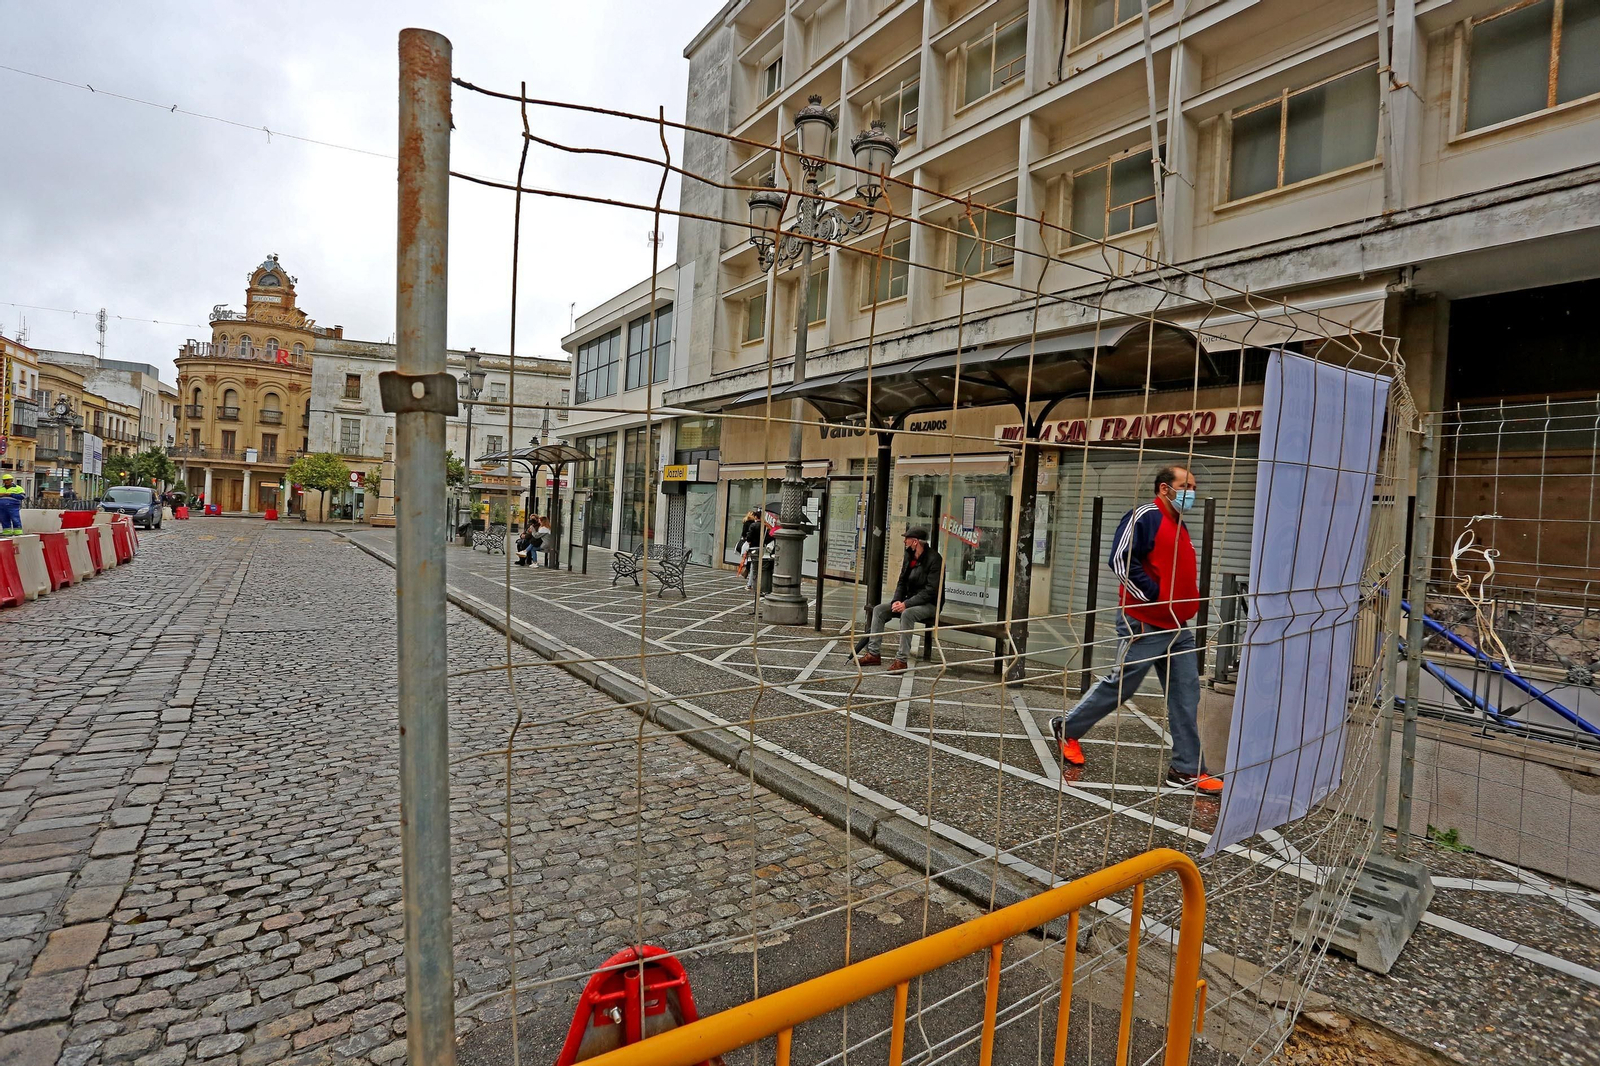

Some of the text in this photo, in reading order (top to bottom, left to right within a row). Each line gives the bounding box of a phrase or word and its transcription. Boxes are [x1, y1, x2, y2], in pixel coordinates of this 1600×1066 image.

[186, 339, 290, 367] FUNDADOR
[910, 419, 947, 432] CALZADOS
[1054, 420, 1092, 444] SAN
[1099, 411, 1217, 441] FRANCISCO
[666, 468, 685, 478] Jazztel
[942, 516, 980, 545] REBAJAS
